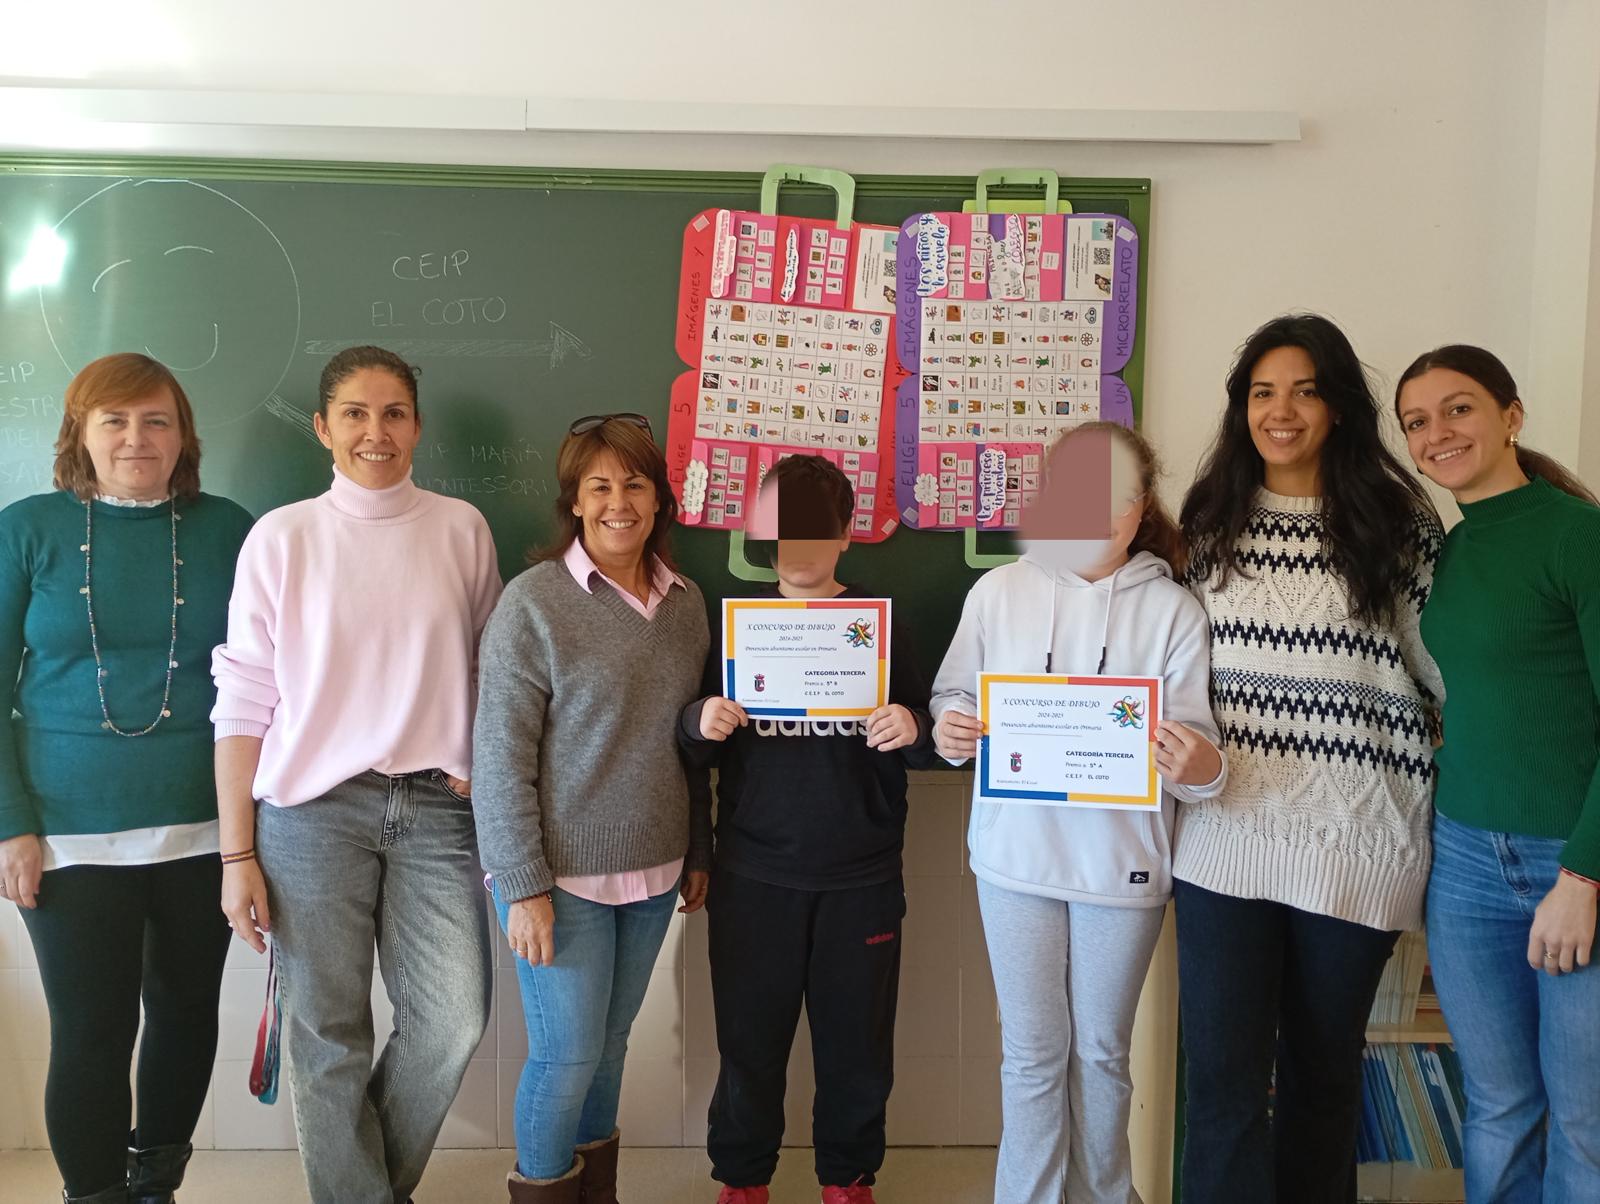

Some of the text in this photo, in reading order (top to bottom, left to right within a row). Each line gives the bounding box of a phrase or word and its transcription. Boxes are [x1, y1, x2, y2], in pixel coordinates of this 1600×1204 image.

[917, 231, 930, 261] niños
[391, 248, 470, 281] CEIP
[370, 296, 508, 328] EL COTO
[685, 272, 701, 342] IMÁGENES
[1115, 247, 1132, 404] UN MICRORRELATO
[0, 361, 35, 384] EIP
[901, 256, 919, 486] ELIGE 5 IMÁGENES
[673, 402, 691, 417] 5
[471, 437, 543, 464] MARÍA
[669, 443, 686, 483] ELIGE
[746, 623, 836, 631] X CONCURSO DE DIBUJO
[1009, 699, 1053, 707] CONCURSO
[1069, 700, 1100, 708] DIBUJO
[1065, 750, 1104, 758] CATEGORÍA
[865, 931, 895, 945] adidas
